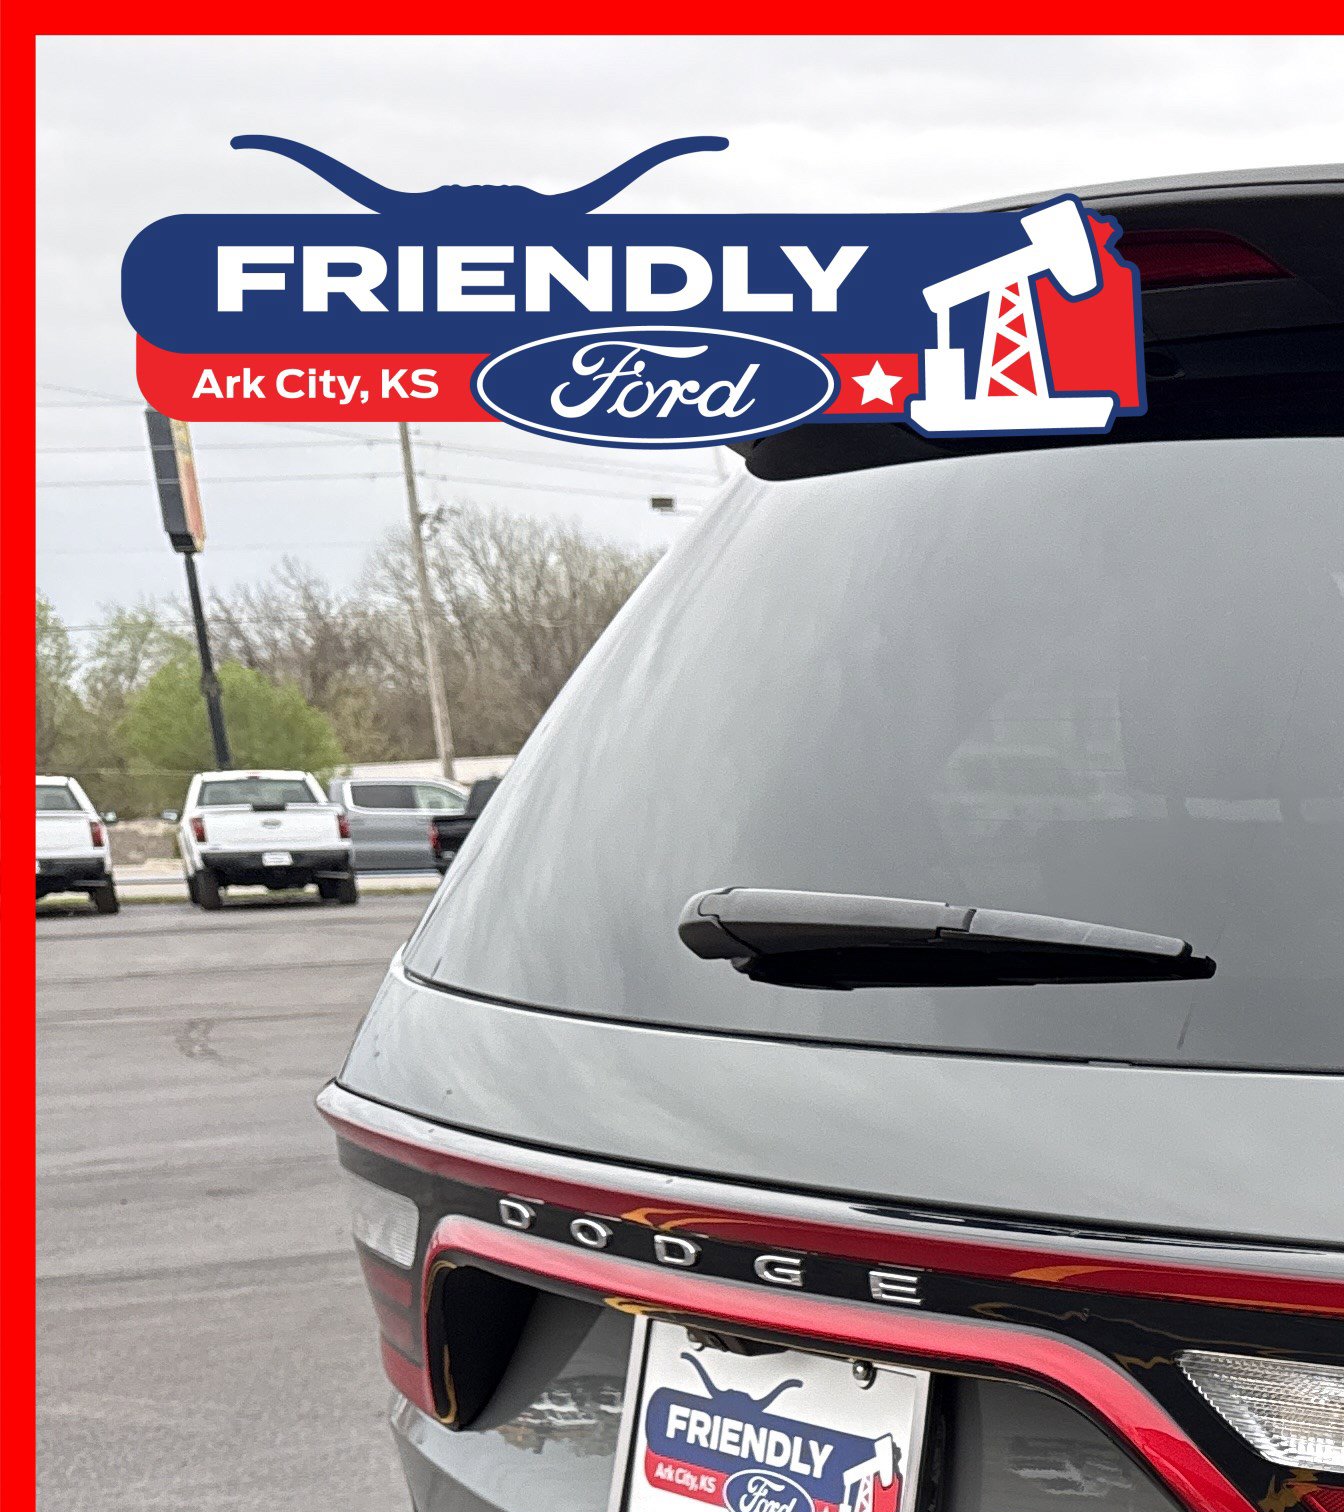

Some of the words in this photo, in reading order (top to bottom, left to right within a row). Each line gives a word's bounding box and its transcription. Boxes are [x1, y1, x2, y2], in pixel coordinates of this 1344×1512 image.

[499, 1199, 922, 1306] DODGE
[654, 1461, 674, 1480] Ark
[700, 1473, 717, 1494] KS
[665, 1403, 833, 1479] FRIENDLY
